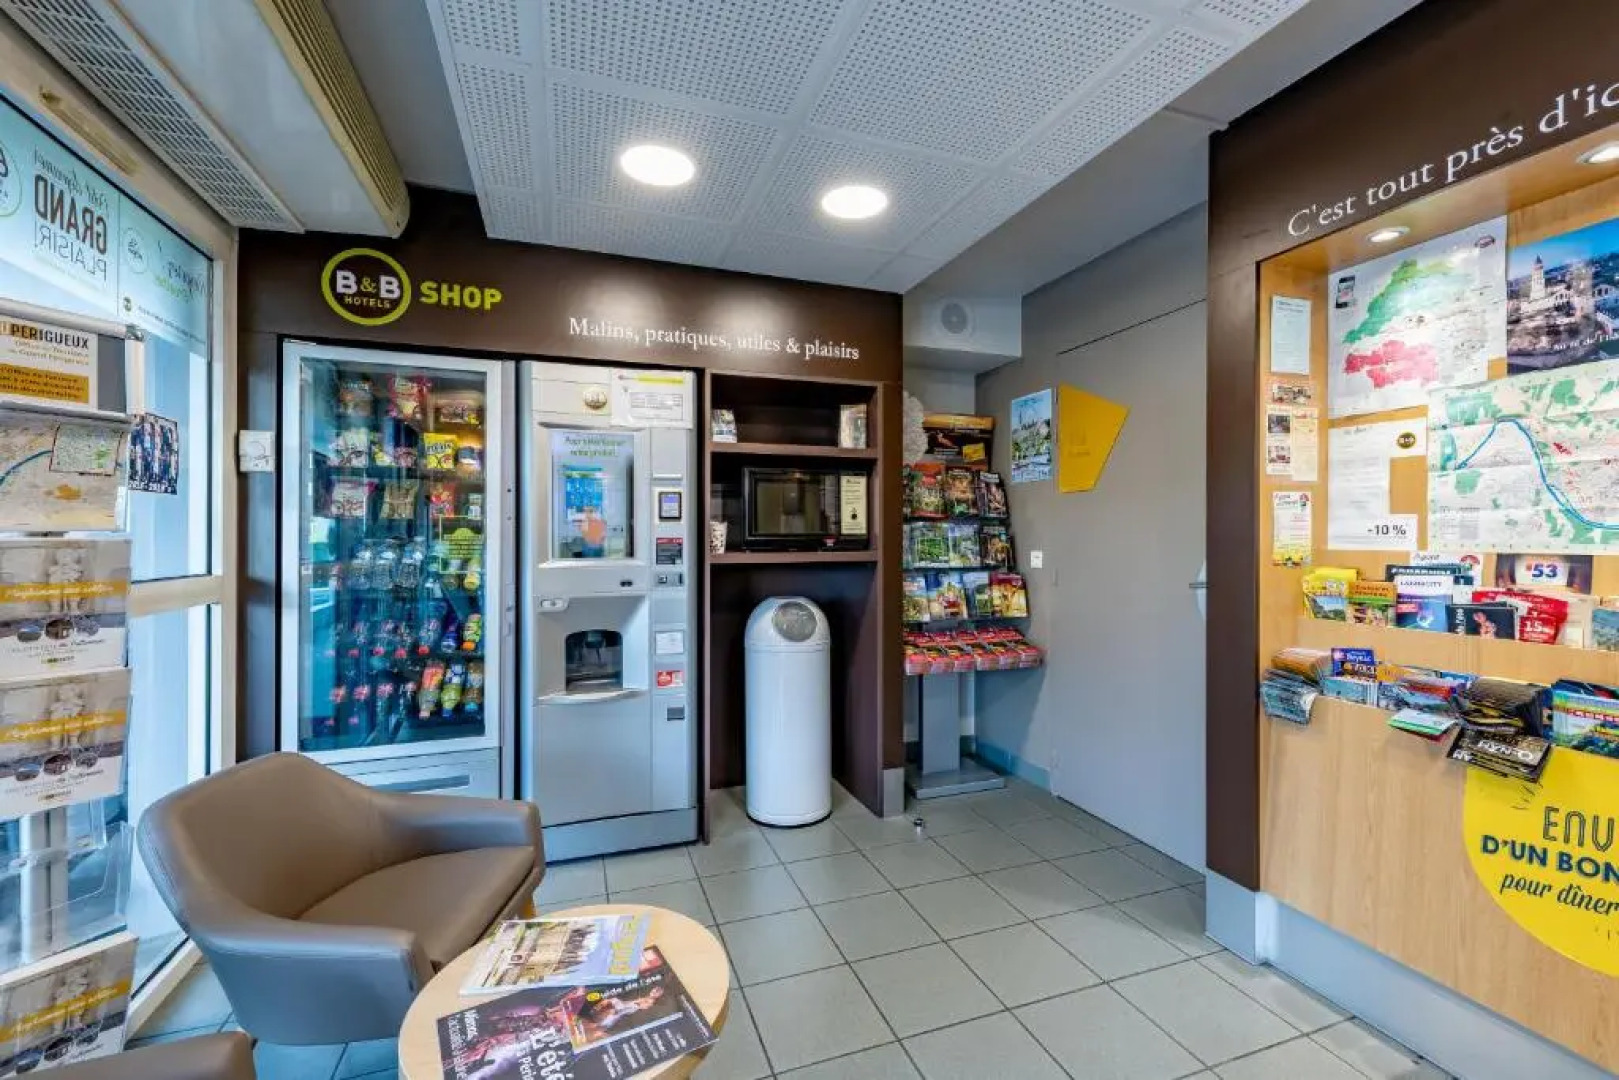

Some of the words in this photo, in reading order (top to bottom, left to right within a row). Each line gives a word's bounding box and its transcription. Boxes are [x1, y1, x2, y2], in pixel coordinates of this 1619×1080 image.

[1287, 194, 1356, 237] C'est
[1366, 163, 1435, 208] tout
[1445, 124, 1525, 184] près
[344, 296, 391, 310] HOTELS
[419, 280, 503, 312] SHOP
[569, 317, 640, 343] Malins,
[645, 325, 732, 351] pratiques,
[737, 332, 781, 353] utiles
[786, 337, 801, 355] &
[804, 339, 860, 361] plaisirs
[1367, 524, 1389, 535] -10
[1392, 524, 1407, 536] %
[1531, 563, 1558, 578] 53
[1481, 833, 1549, 868] D'UN
[1556, 850, 1619, 884] BON
[1500, 873, 1553, 898] pour
[1557, 883, 1619, 917] dîner
